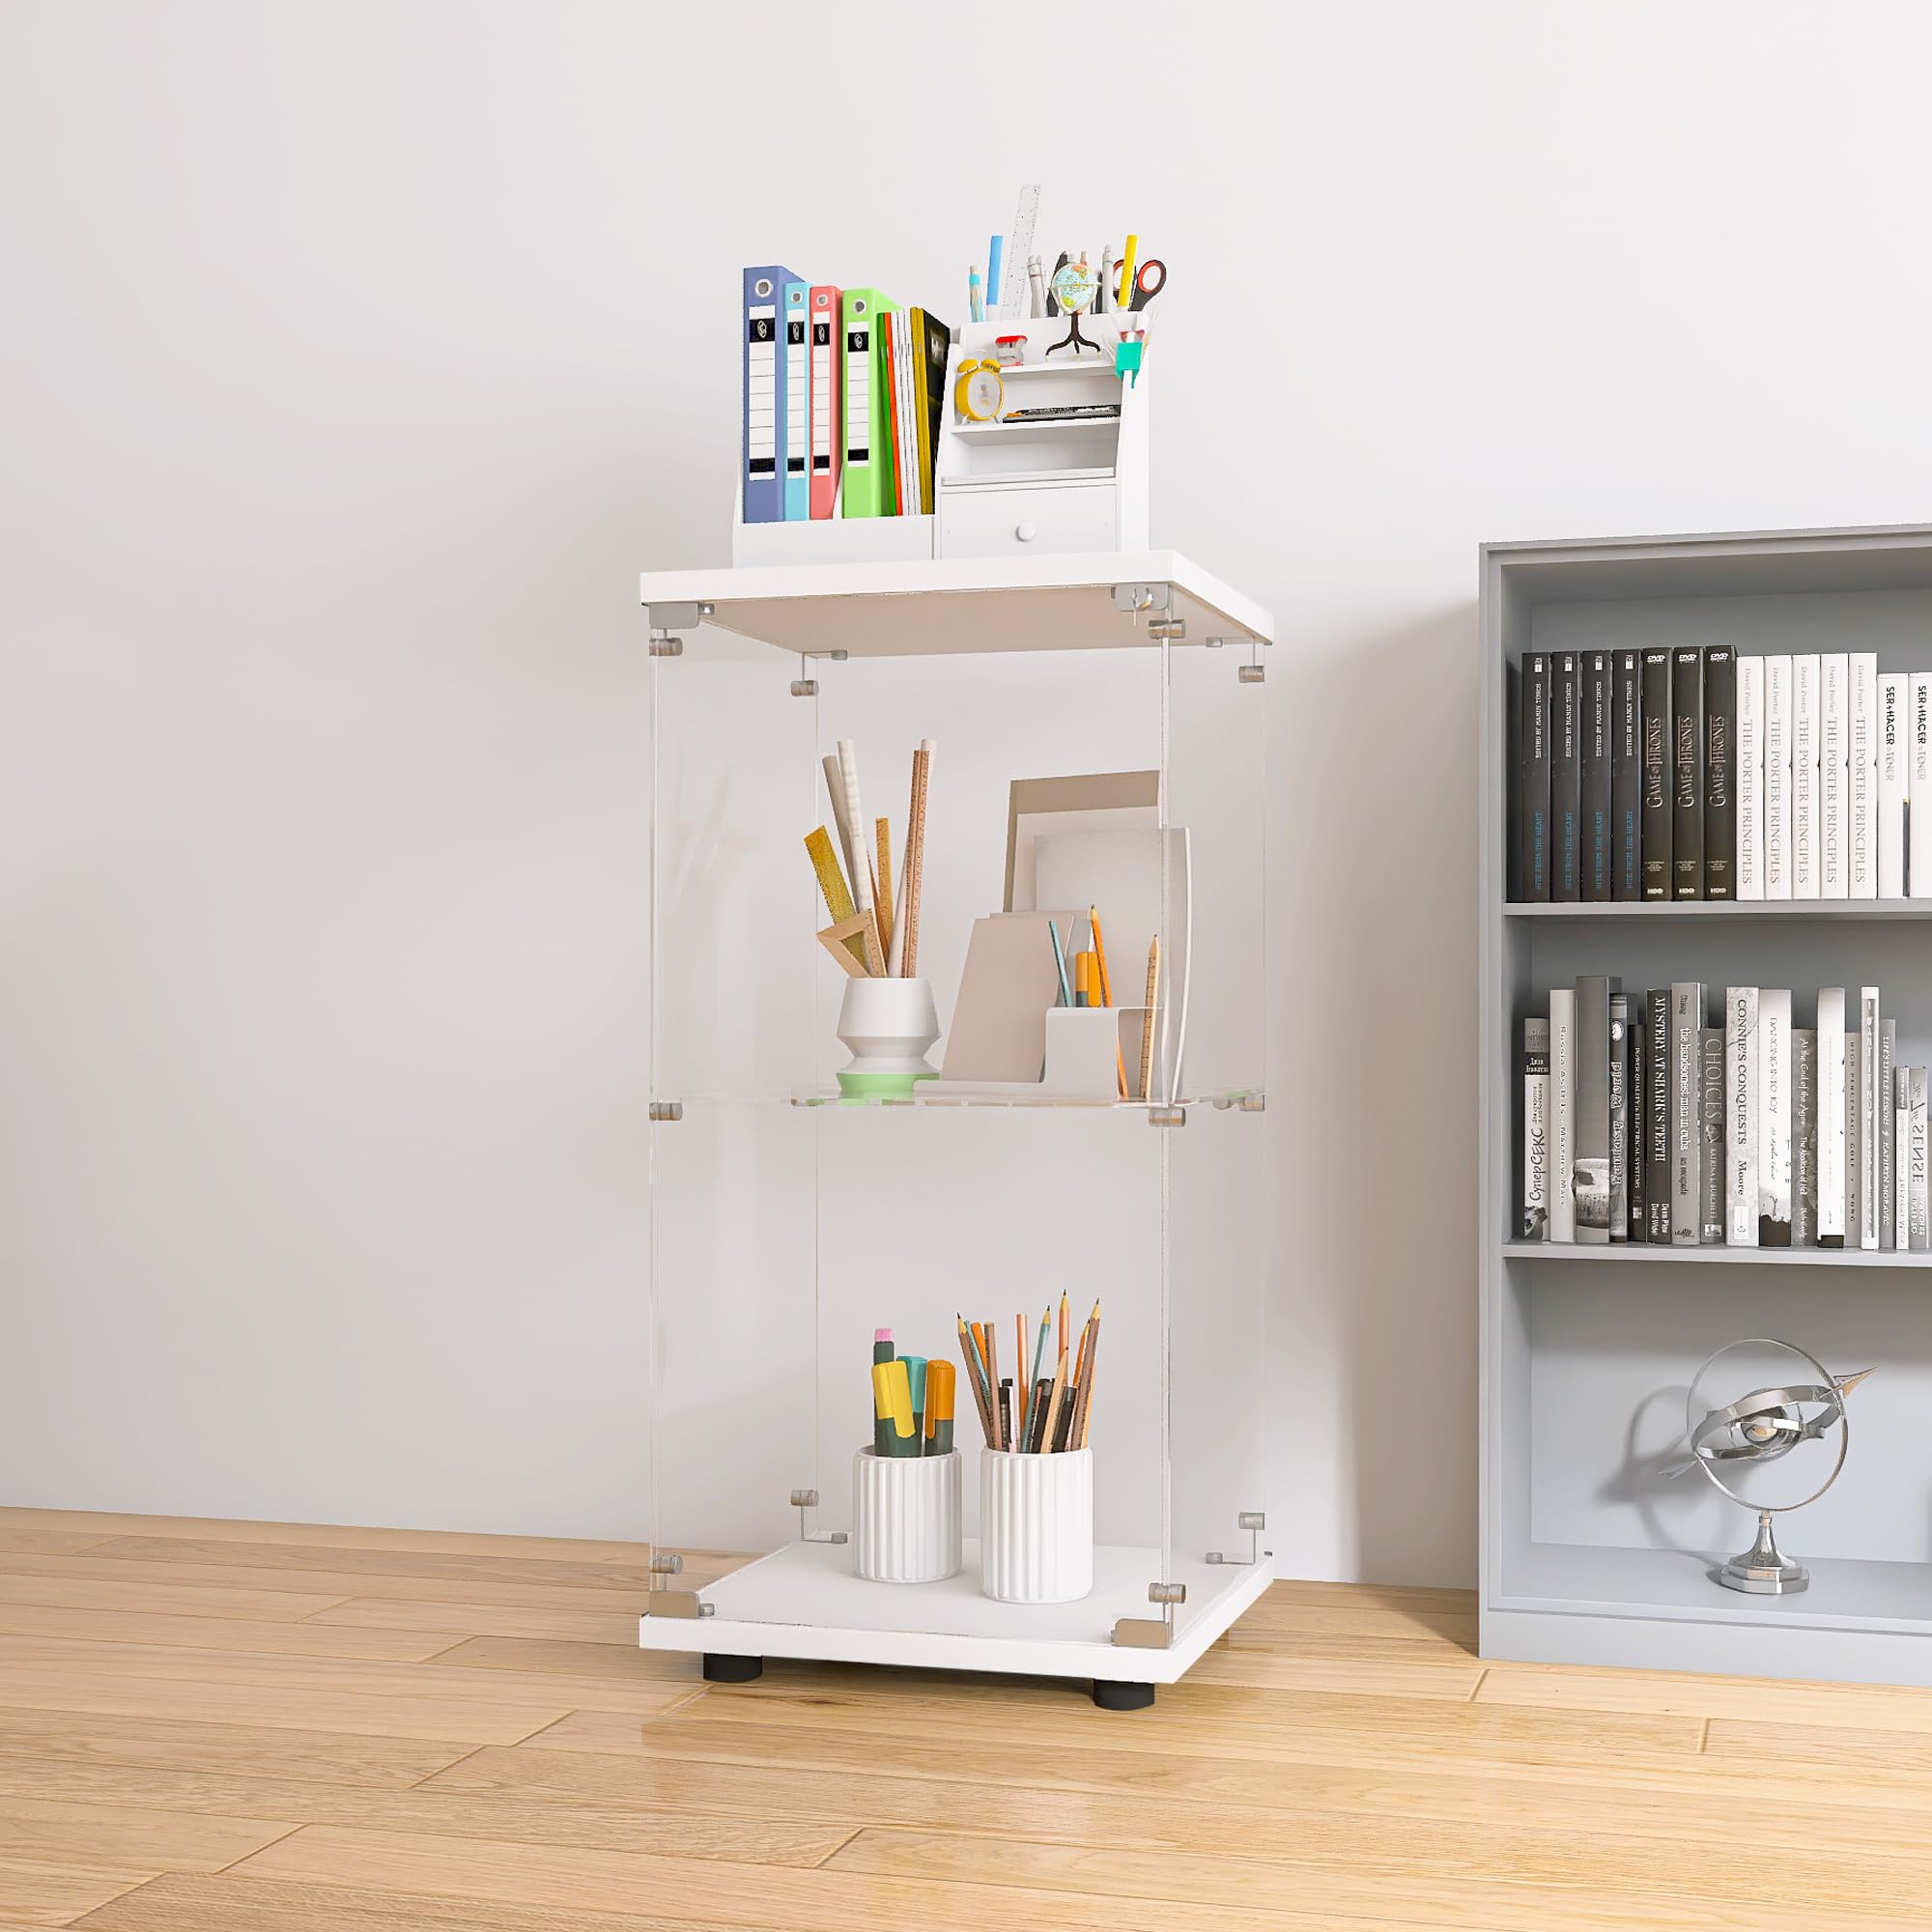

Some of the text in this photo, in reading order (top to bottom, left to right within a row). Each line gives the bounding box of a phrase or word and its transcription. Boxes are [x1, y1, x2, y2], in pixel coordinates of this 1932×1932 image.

[1647, 654, 1665, 663] DVD
[1646, 717, 1662, 767] THRONES
[1678, 715, 1694, 767] THRONES
[1710, 714, 1725, 766] THRONES
[1646, 774, 1662, 808] GAME
[1678, 773, 1694, 807] GAME
[1709, 773, 1726, 807] GAME
[1742, 720, 1752, 885] THE PORTER PRINCIPLES
[1770, 719, 1780, 885] THE PORTER PRINCIPLES
[1799, 718, 1809, 884] THE PORTER PRINCIPLES
[1827, 717, 1837, 884] THE PORTER PRINCIPLES
[1856, 716, 1865, 883] THE PORTER PRINCIPLES
[1770, 1017, 1778, 1066] DANCING
[1800, 1051, 1808, 1063] the
[1610, 1061, 1623, 1109] World
[1654, 997, 1666, 1162] MYSTERY AT SHARK'S TEETH
[1680, 1028, 1691, 1151] the handsomest man in cuba
[1704, 1038, 1721, 1119] CHOICES
[1736, 999, 1747, 1195] CONNIE'S CONQUESTS Moore
[1800, 1064, 1808, 1080] End
[1800, 1091, 1808, 1102] the
[1799, 1104, 1808, 1125] Ages
[1529, 1127, 1546, 1201] СуперСЕКС
